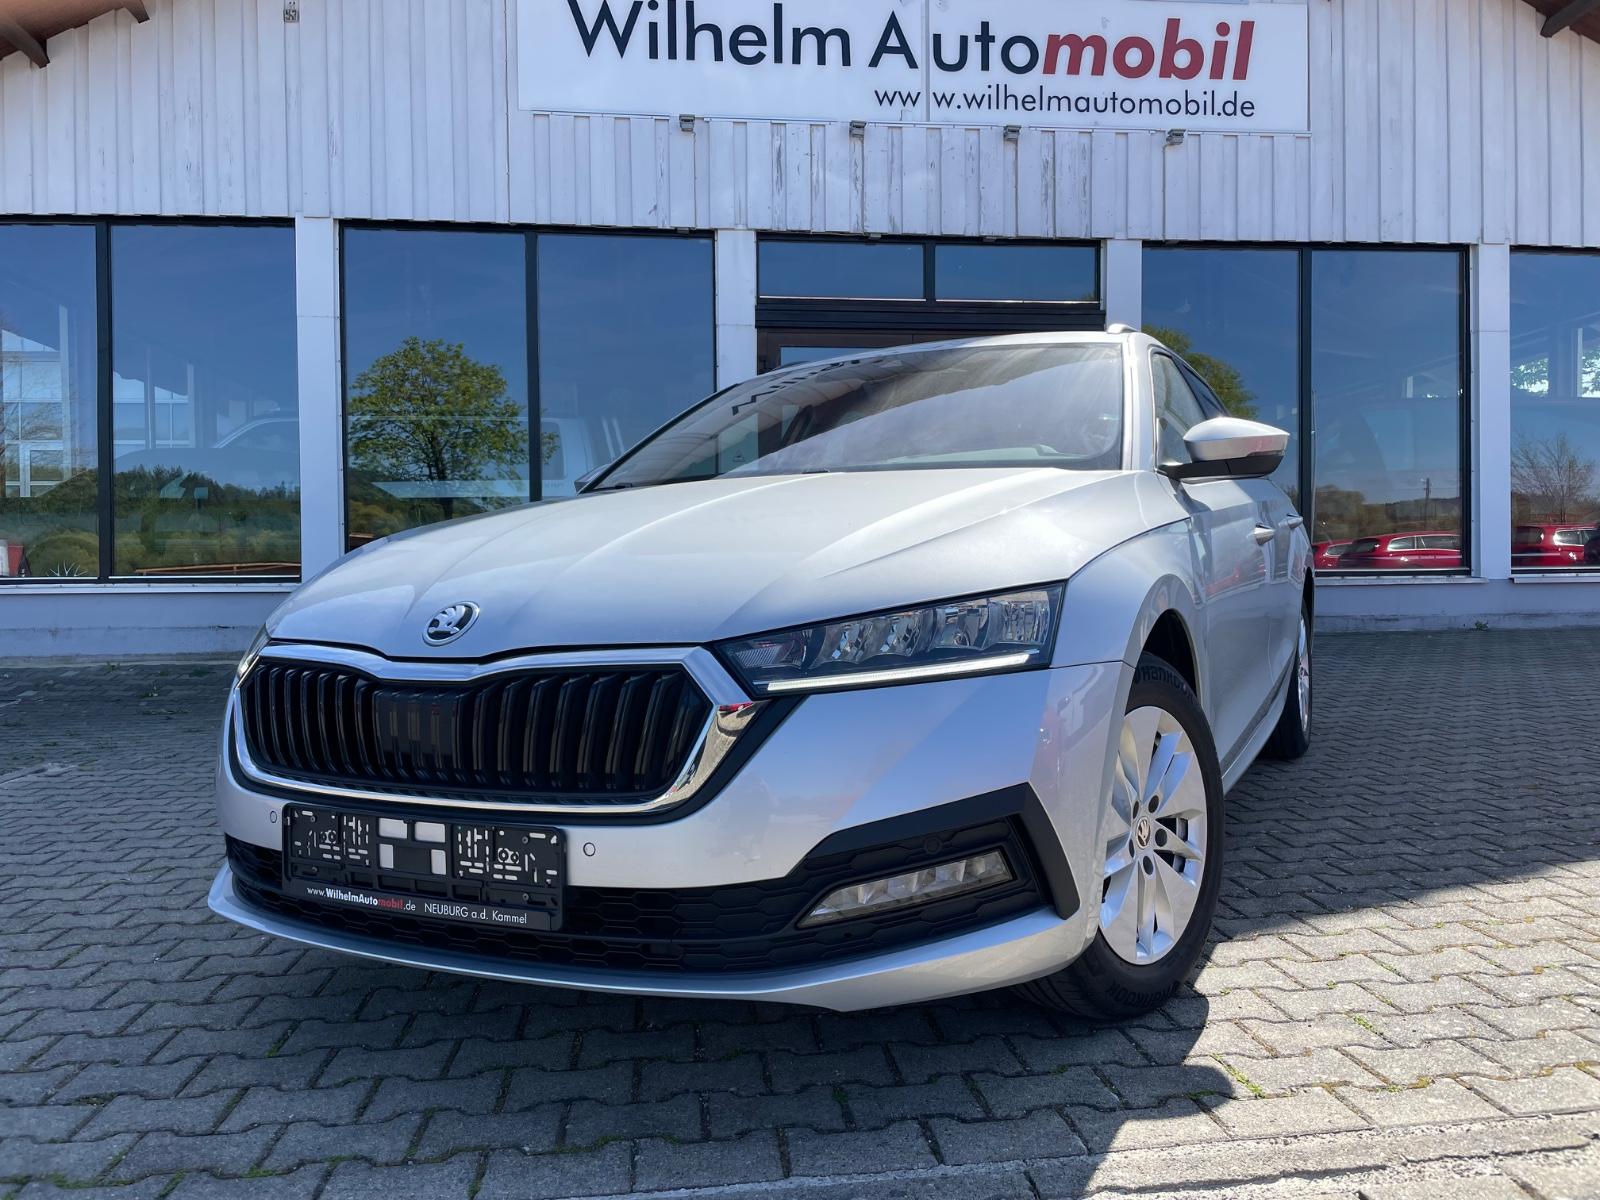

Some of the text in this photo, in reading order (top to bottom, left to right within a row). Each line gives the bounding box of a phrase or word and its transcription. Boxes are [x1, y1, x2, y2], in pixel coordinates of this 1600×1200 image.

[567, 0, 1255, 80] Wilhelm Automobil
[874, 84, 1255, 117] www.wilhelmautomobil.de
[306, 887, 416, 911] www.WilhelmAutomobil.de
[424, 902, 469, 918] NEUBURG
[492, 910, 527, 924] Kammel
